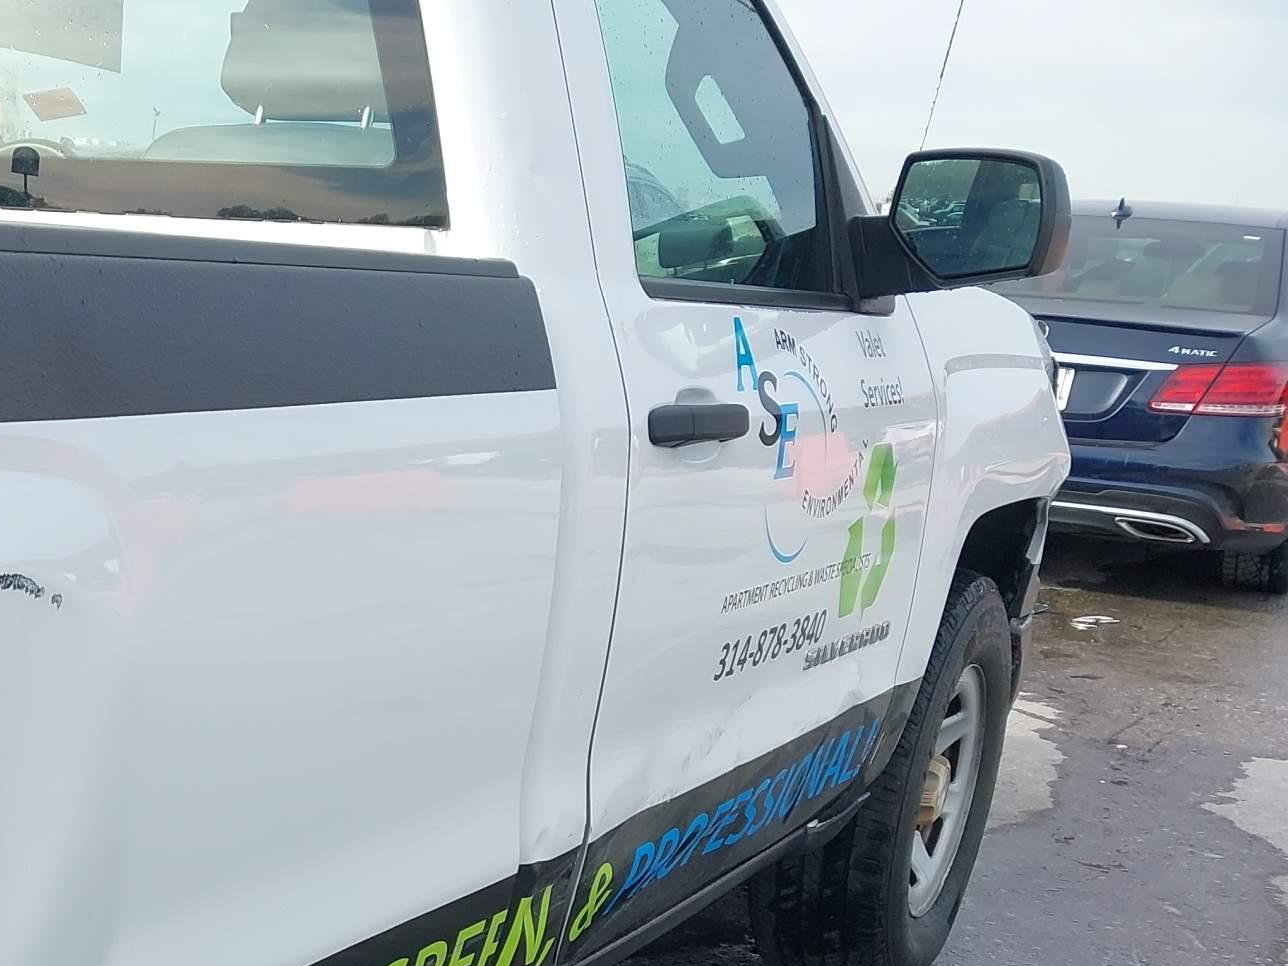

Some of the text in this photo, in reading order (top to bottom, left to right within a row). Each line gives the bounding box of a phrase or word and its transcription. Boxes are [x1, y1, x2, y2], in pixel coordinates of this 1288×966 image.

[856, 329, 887, 358] Valet
[1167, 345, 1219, 358] 4MATIC
[861, 375, 905, 409] Services!
[721, 584, 770, 614] APARTMENT
[768, 570, 810, 601] RECYCLING
[814, 564, 837, 586] WASTE
[834, 552, 872, 578] SPECIALISTS
[713, 608, 828, 682] 314-878-3840
[568, 862, 613, 942] &
